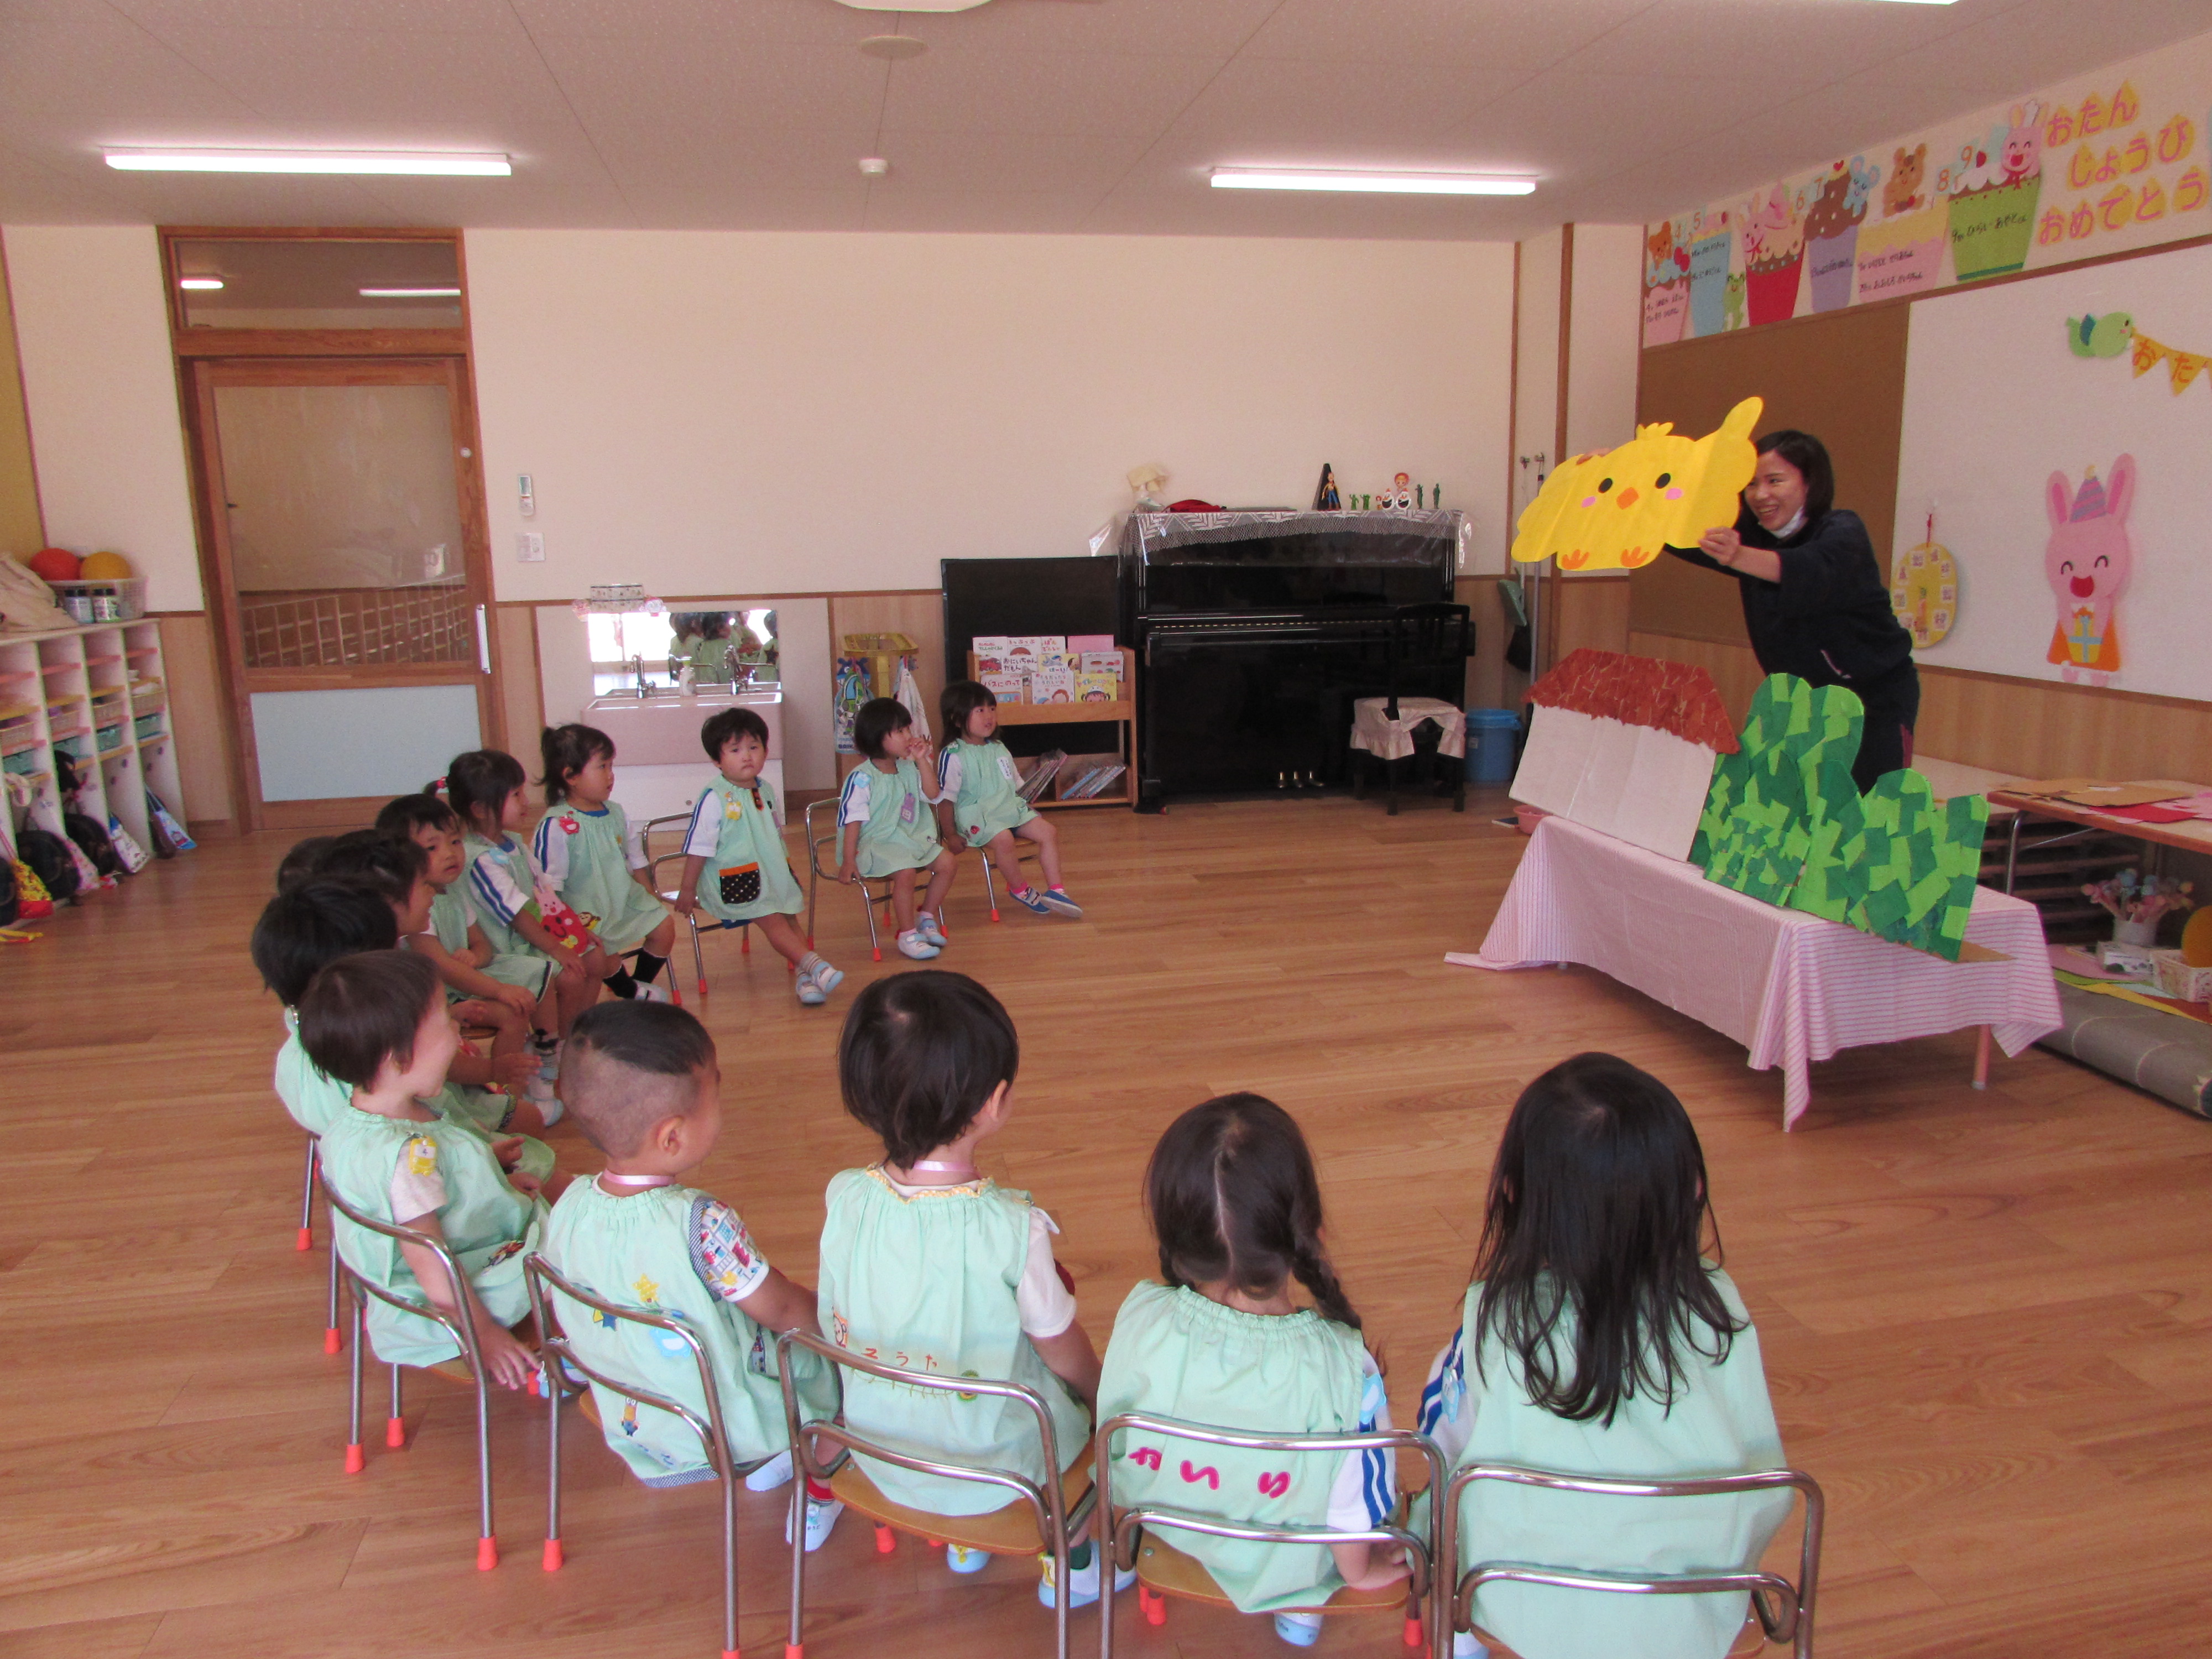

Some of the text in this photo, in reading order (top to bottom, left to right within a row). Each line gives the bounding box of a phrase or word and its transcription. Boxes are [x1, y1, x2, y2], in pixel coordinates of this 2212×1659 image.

[2047, 87, 2138, 148] おたん
[1961, 145, 1974, 169] 9
[1814, 178, 1824, 199] 7
[2040, 171, 2204, 245] おめでとう
[1693, 211, 1701, 230] 5
